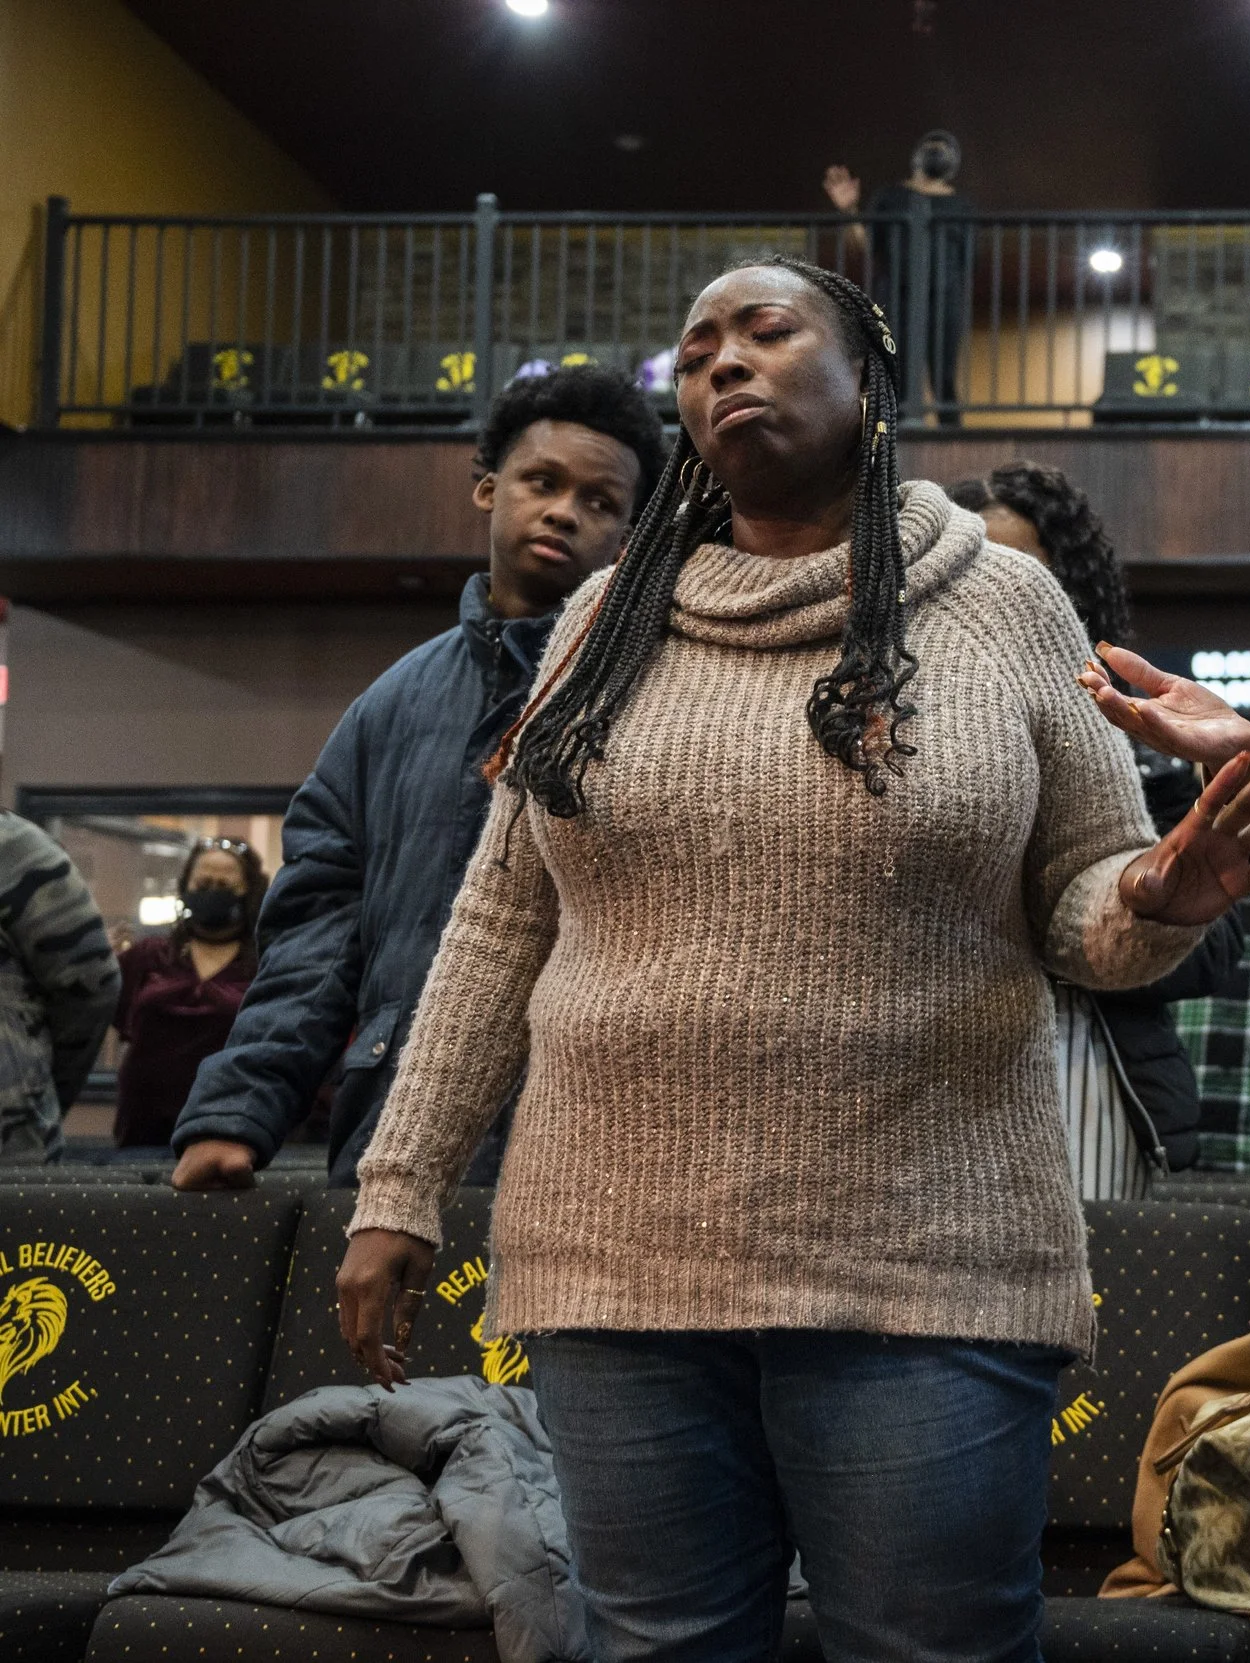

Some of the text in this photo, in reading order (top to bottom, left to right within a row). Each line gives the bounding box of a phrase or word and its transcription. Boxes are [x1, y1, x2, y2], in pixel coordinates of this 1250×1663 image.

[18, 1242, 116, 1301] BELIEVERS
[436, 1256, 488, 1305] REAL
[1060, 1392, 1104, 1434] INT.
